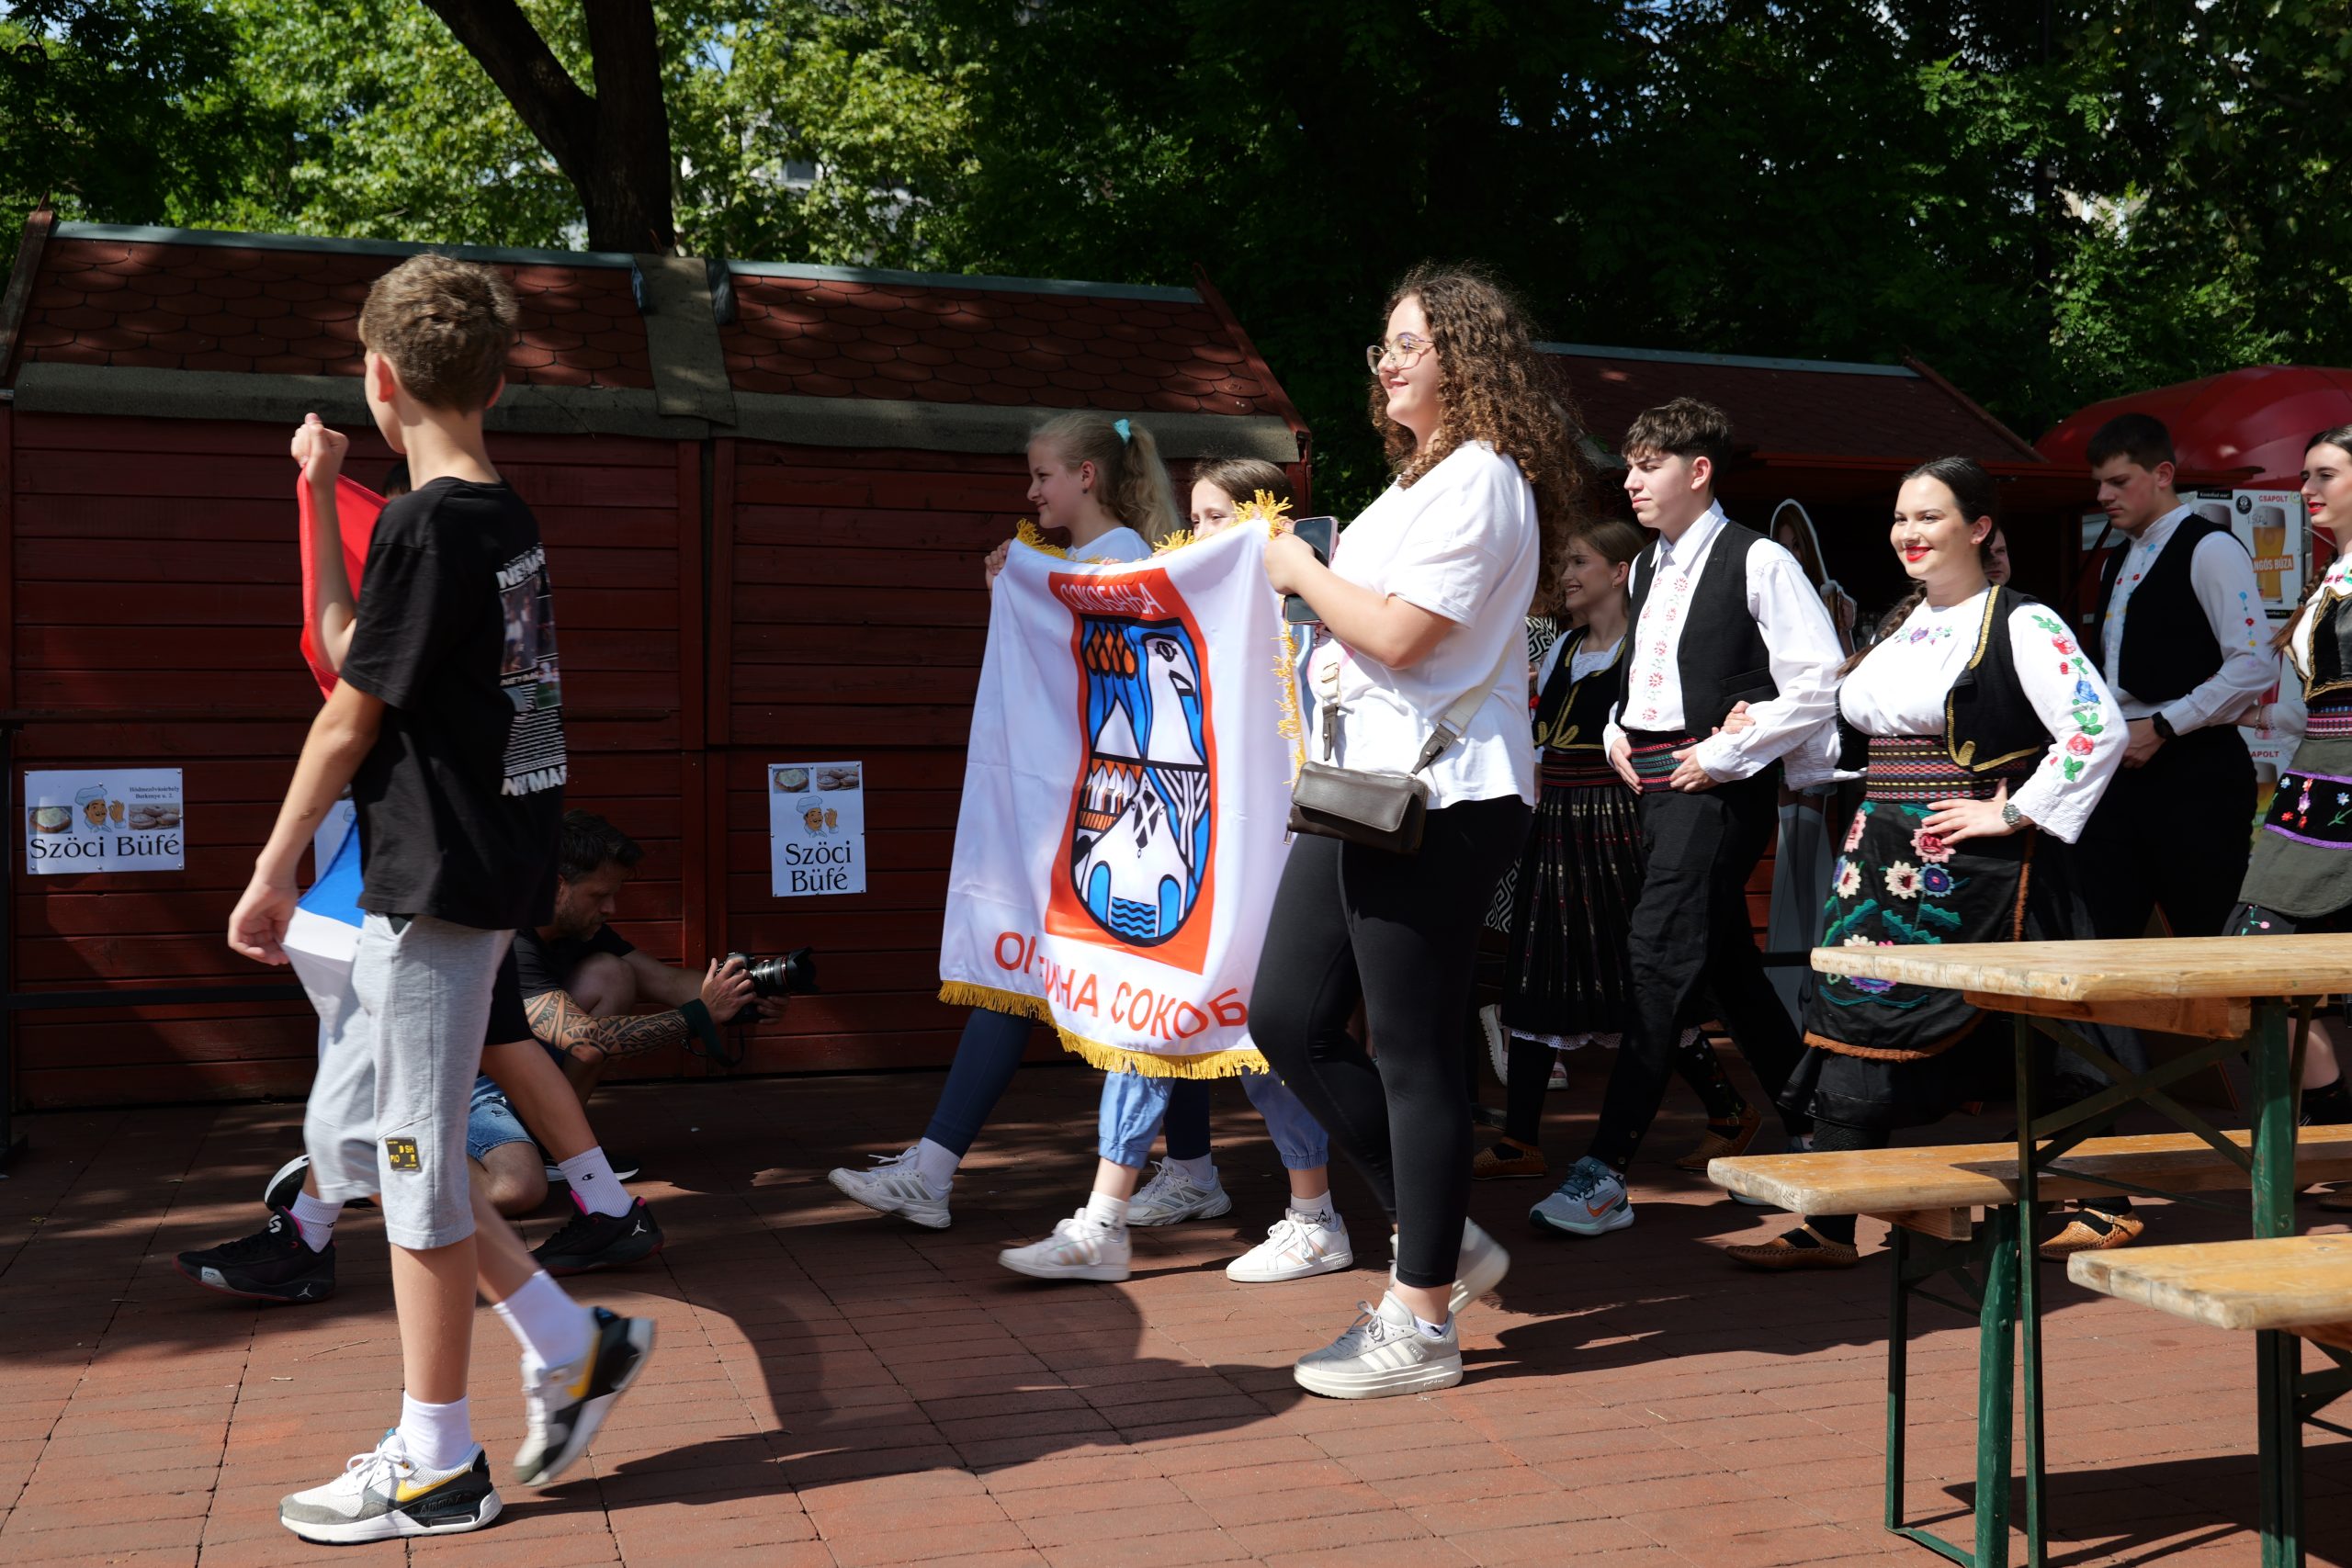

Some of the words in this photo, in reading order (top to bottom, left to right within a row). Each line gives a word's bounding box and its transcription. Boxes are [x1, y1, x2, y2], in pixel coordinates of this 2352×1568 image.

[2254, 558, 2273, 570] NGÓS
[29, 836, 105, 859] Szöci
[117, 833, 180, 856] Büfé
[786, 840, 852, 865] Szöci
[790, 866, 848, 892] Büfé
[1111, 981, 1249, 1041] СОКОБ
